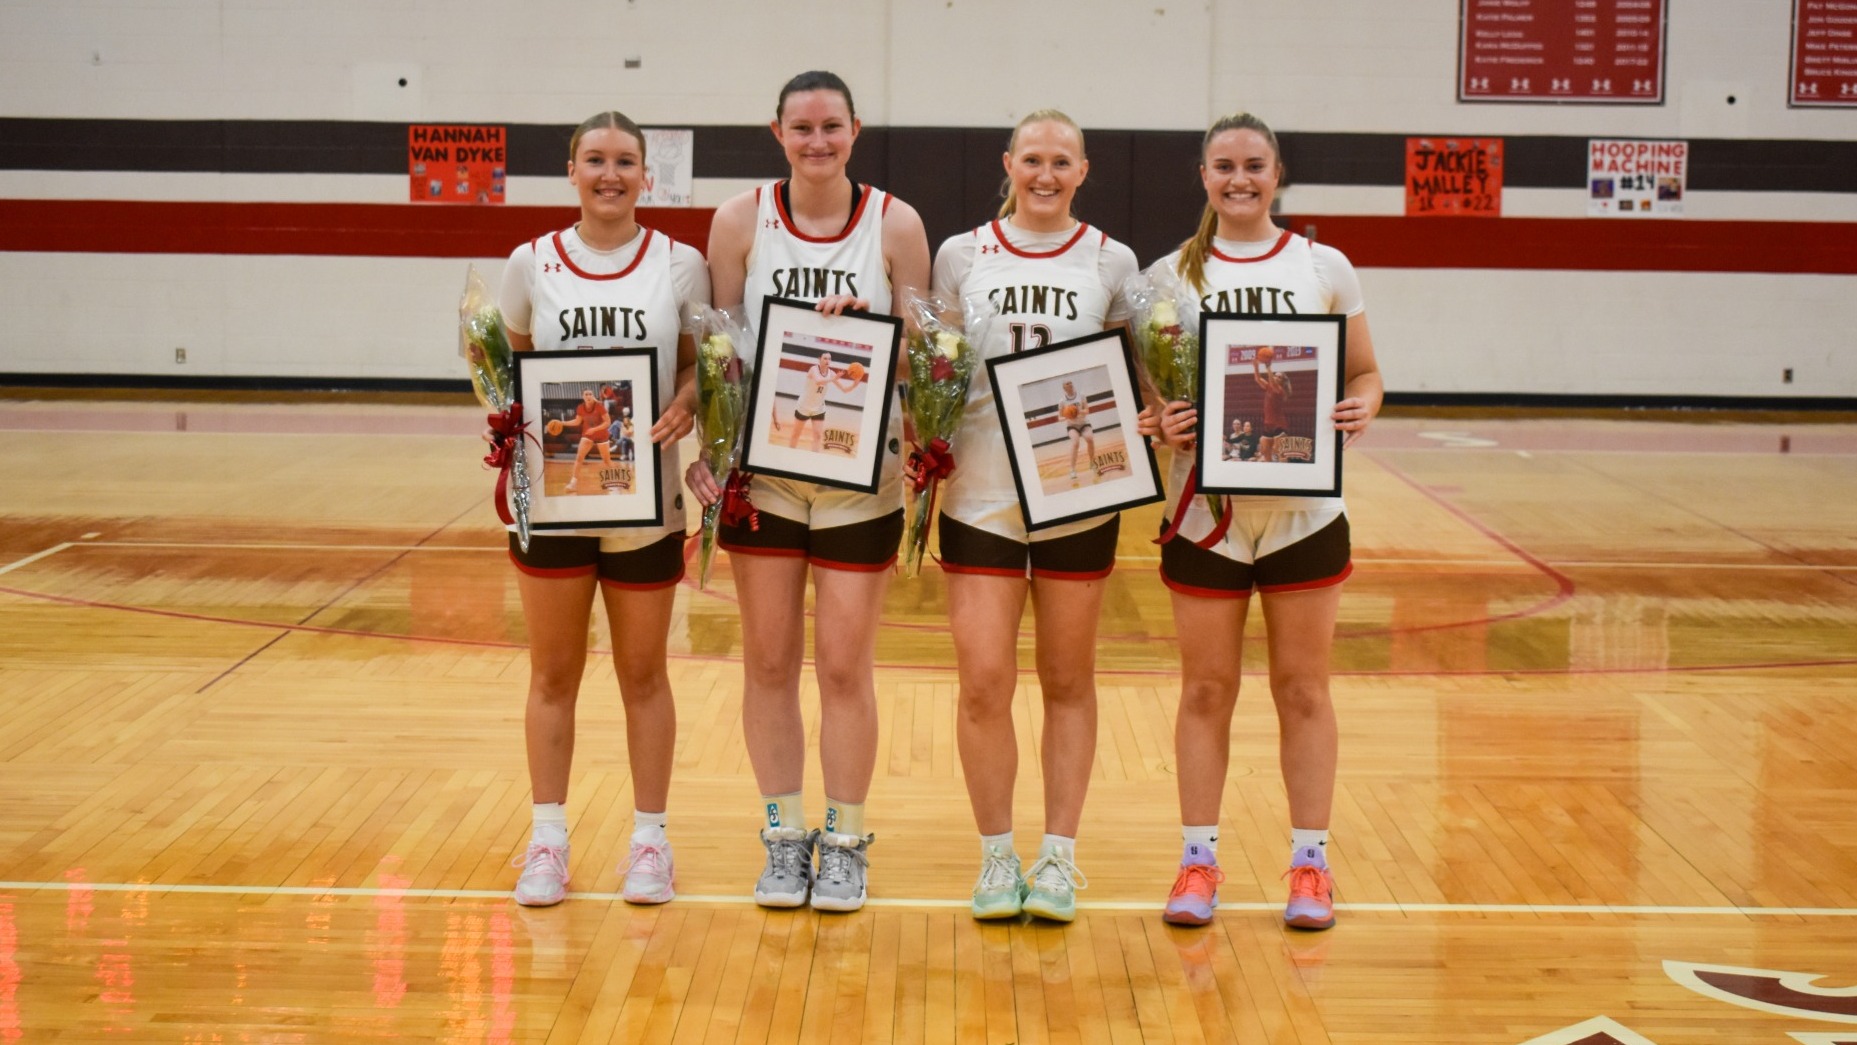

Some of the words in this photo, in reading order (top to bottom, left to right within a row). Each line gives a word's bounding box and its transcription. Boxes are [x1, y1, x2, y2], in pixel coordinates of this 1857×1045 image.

[414, 128, 500, 143] HANNAH
[411, 146, 448, 162] VAN
[456, 147, 504, 163] DYKE
[1591, 143, 1685, 158] HOOPING
[1415, 149, 1487, 174] JACKIE
[1591, 159, 1683, 175] MACHINE
[1412, 174, 1489, 196] MALLEY
[1620, 175, 1655, 190] #14
[773, 267, 859, 298] SAINTS
[988, 285, 1078, 321] SAINTS
[1200, 287, 1298, 314] SAINTS
[559, 306, 647, 342] SAINTS
[823, 430, 855, 446] SAINTS
[1093, 451, 1125, 469] SAINTS
[600, 469, 631, 482] SAINTS
